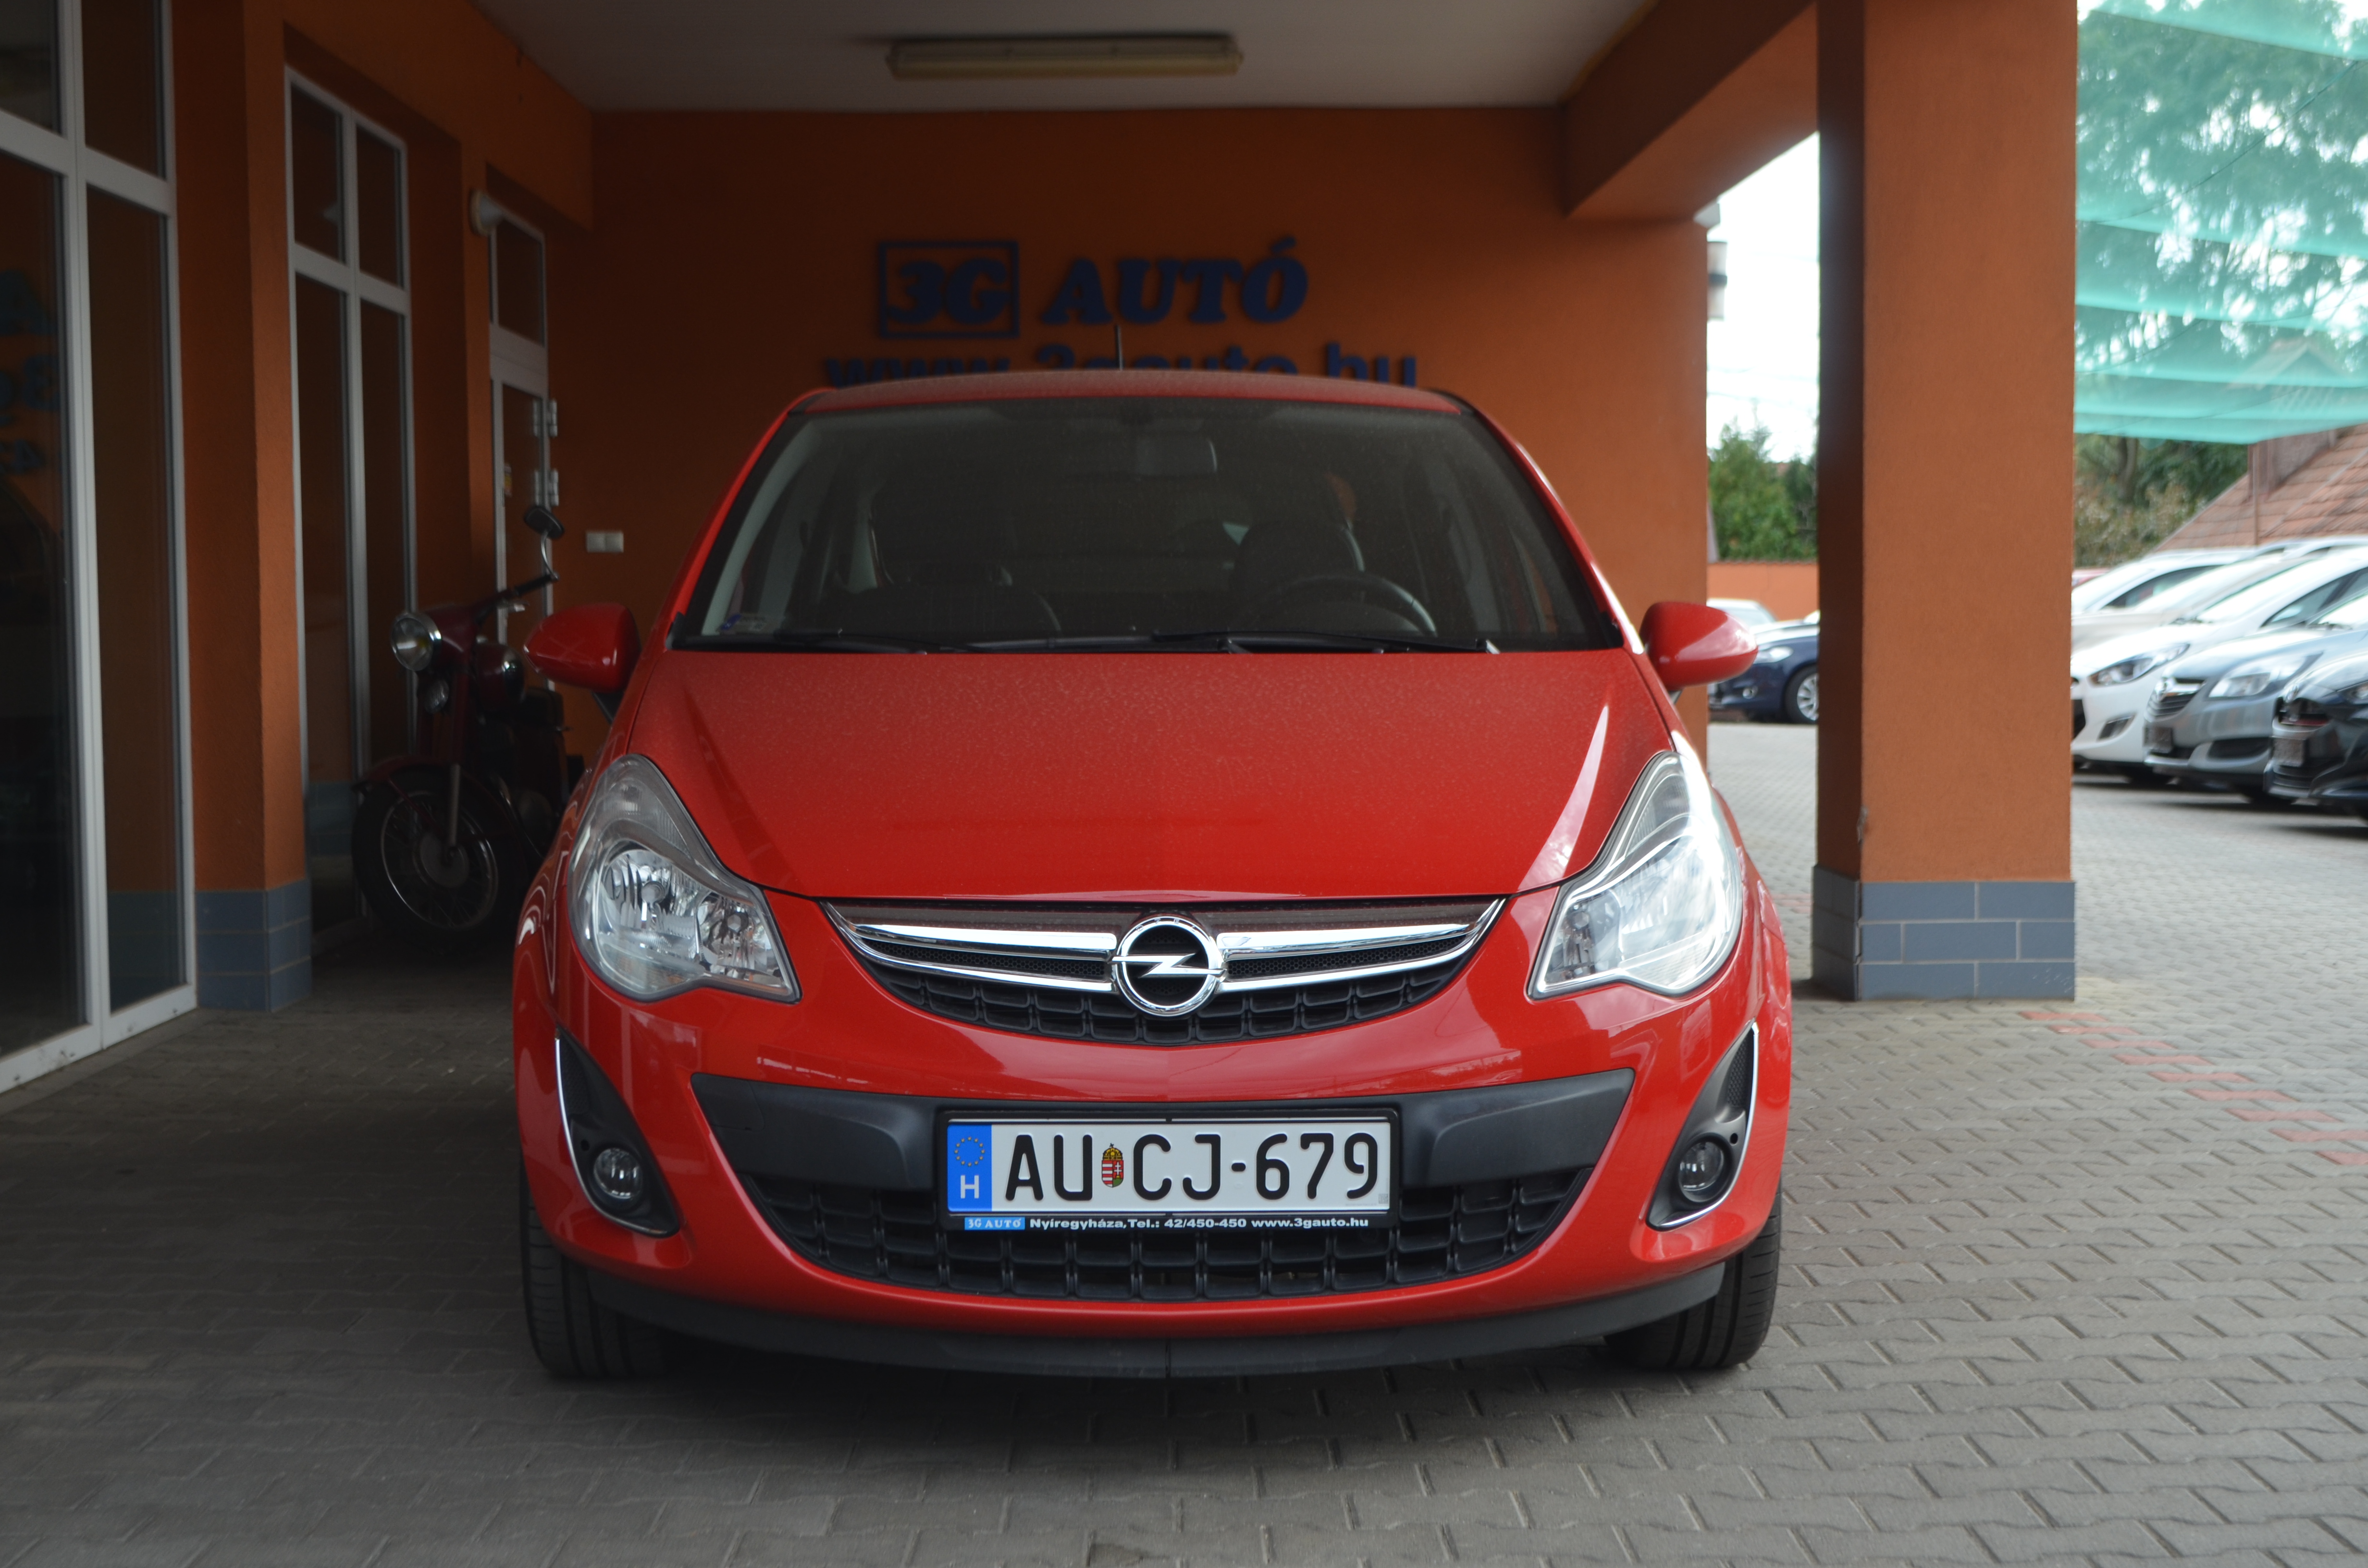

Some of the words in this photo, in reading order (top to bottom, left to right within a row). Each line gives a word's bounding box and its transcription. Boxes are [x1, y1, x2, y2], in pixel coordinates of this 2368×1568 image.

[887, 257, 1011, 324] 3G
[1041, 236, 1309, 324] AUTÓ
[961, 1175, 979, 1199] H
[1133, 1132, 1379, 1200] CJ-679
[968, 1218, 982, 1228] 3G
[1164, 1218, 1247, 1228] 42/450-450
[1251, 1217, 1369, 1229] www.3gauto.hu
